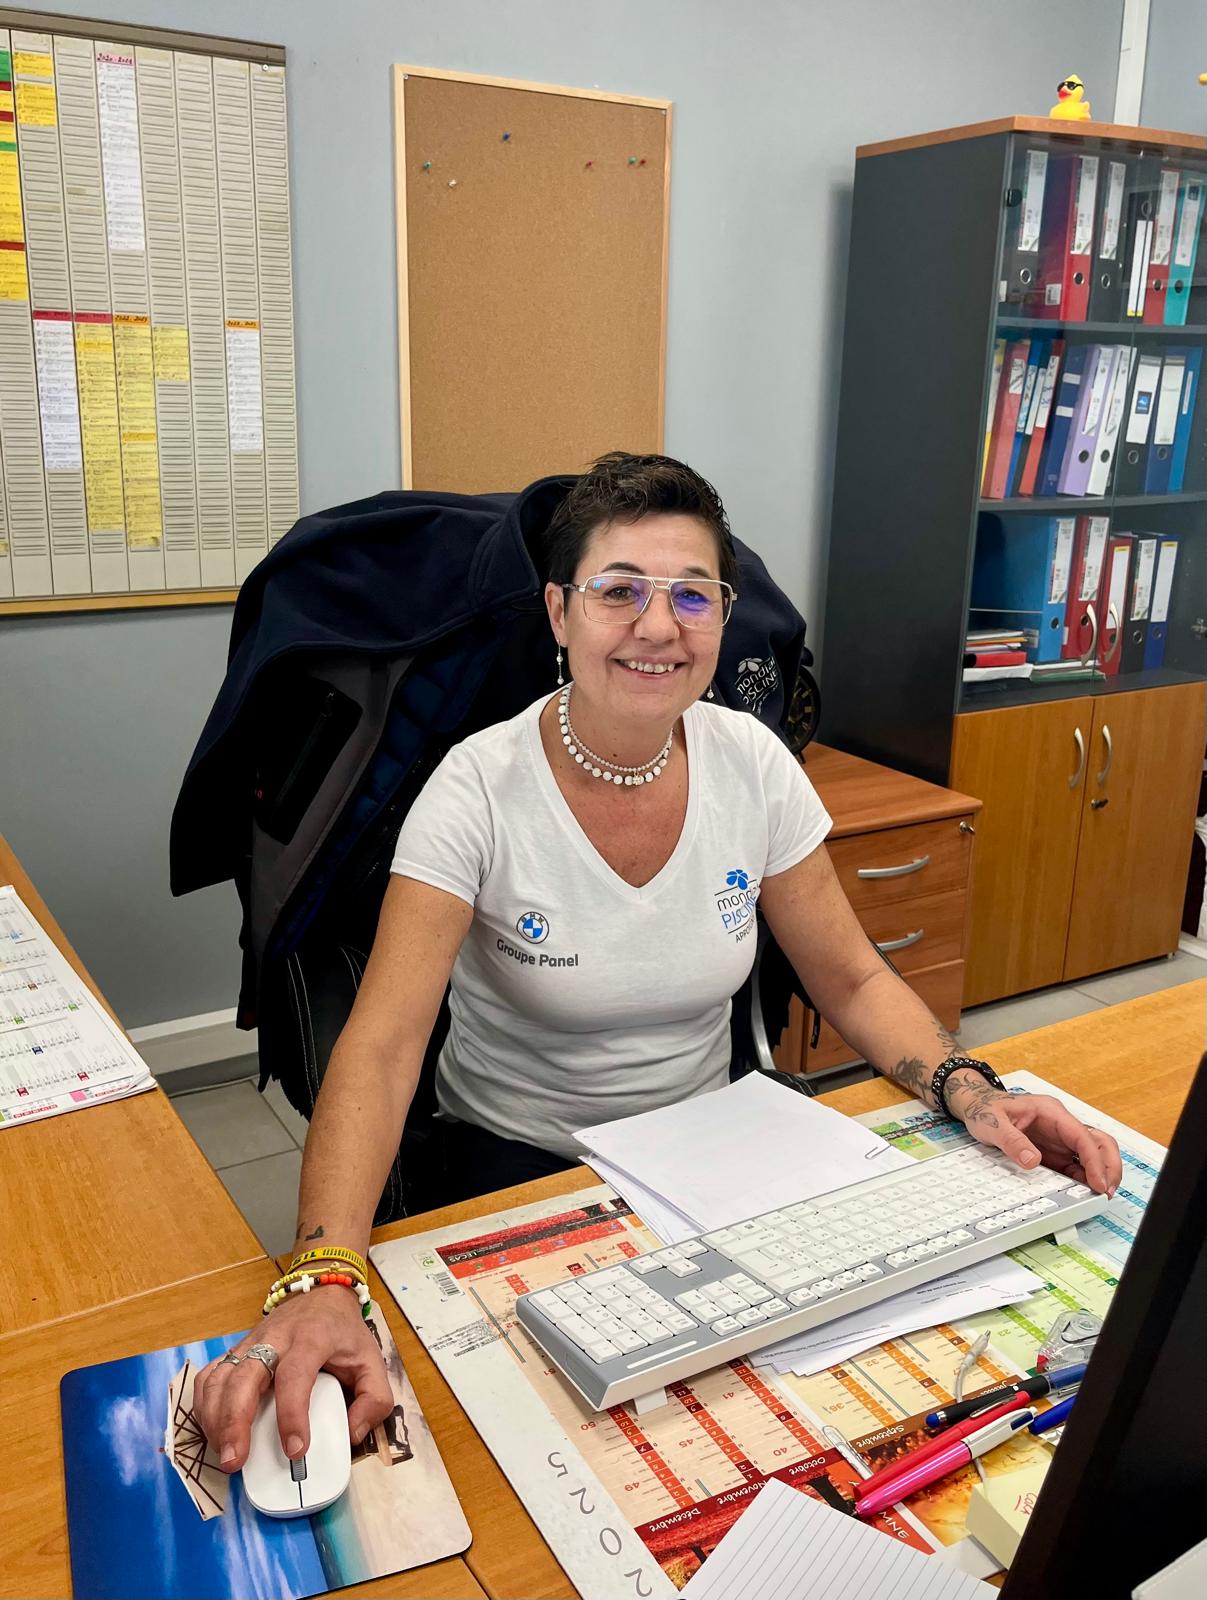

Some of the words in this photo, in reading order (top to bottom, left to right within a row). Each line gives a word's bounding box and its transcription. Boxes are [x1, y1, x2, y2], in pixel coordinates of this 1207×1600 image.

[496, 938, 536, 965] Groupe
[539, 953, 579, 967] Panel
[722, 1392, 734, 1400] 41
[580, 1421, 597, 1431] 50
[678, 1438, 694, 1448] 45
[856, 1424, 905, 1448] Septembre
[773, 1447, 788, 1457] 40
[788, 1456, 826, 1475] Octobre
[624, 1481, 640, 1492] 49
[716, 1480, 767, 1505] Novembre
[649, 1507, 702, 1532] Décembre
